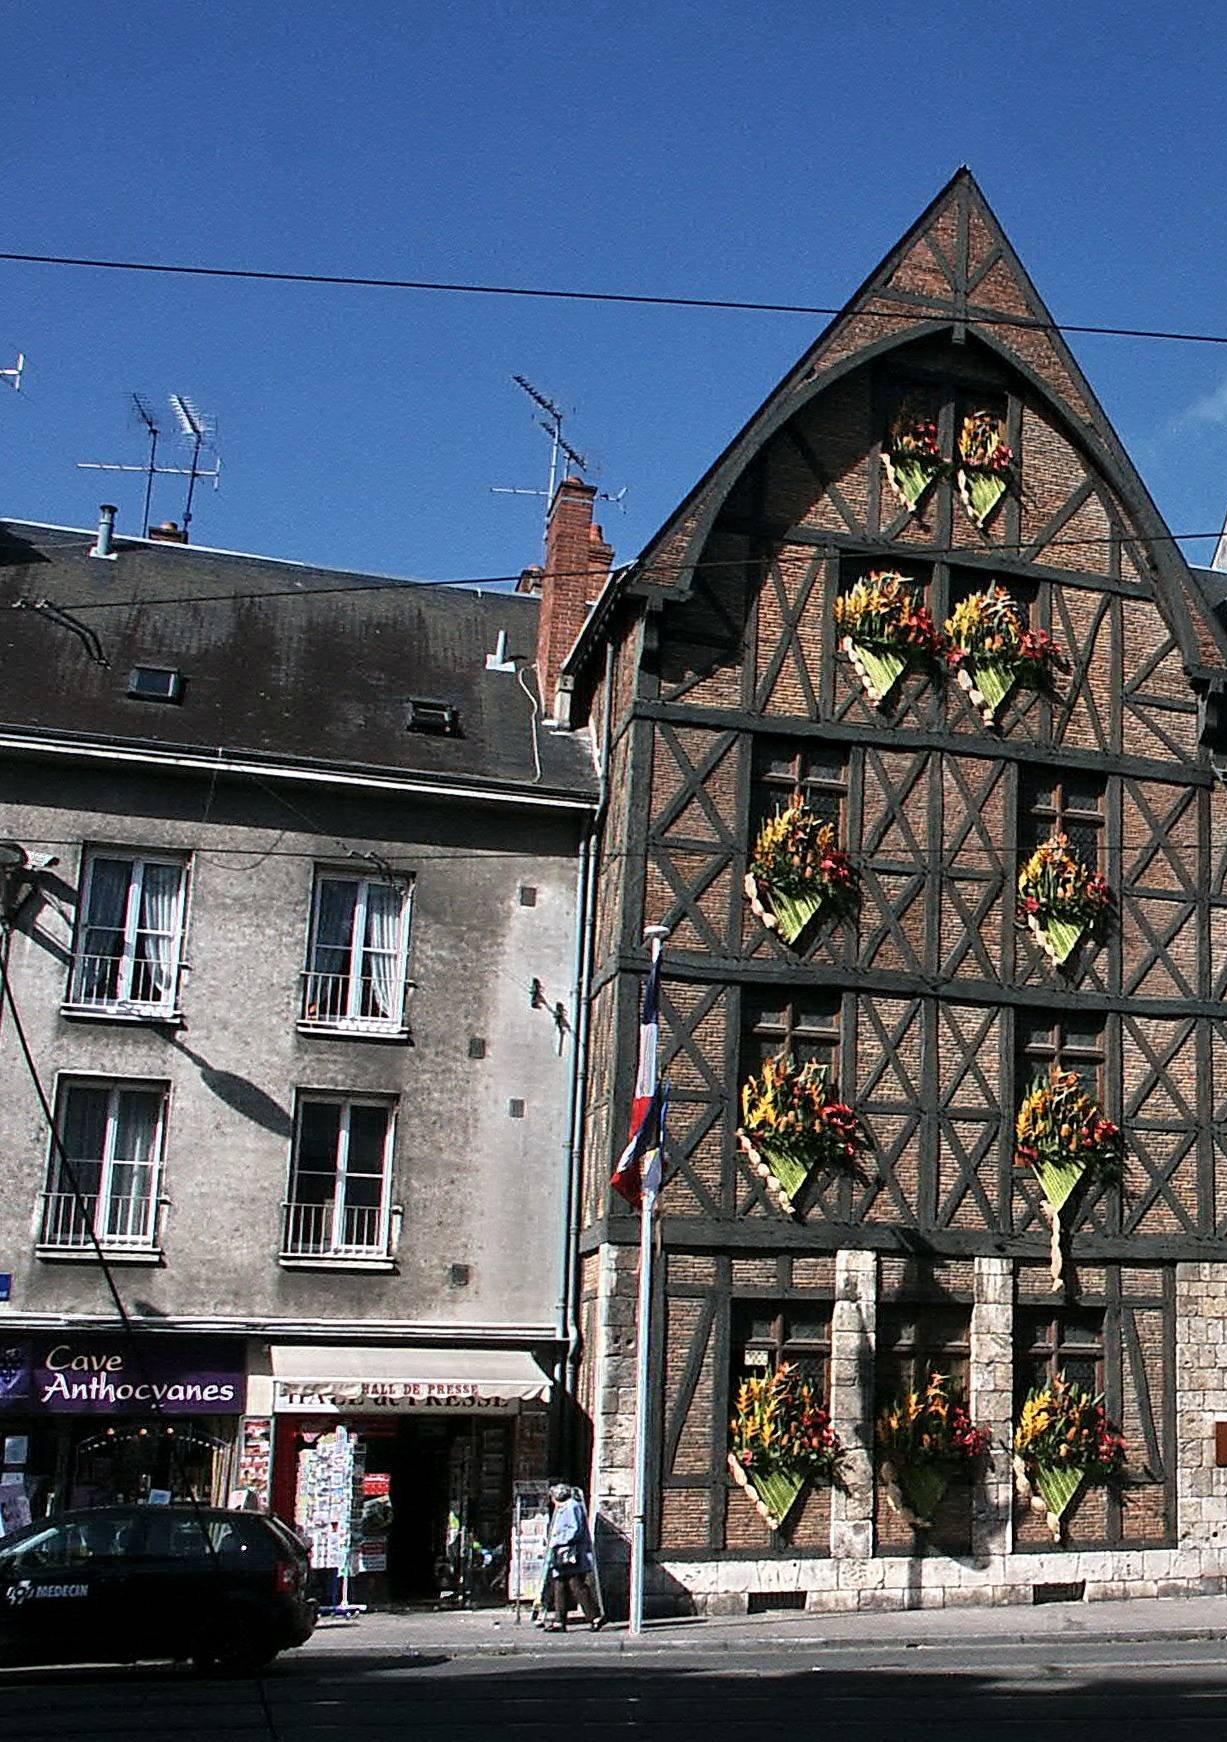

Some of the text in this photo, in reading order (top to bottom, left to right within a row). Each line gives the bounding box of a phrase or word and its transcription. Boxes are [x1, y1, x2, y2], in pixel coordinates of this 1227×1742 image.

[46, 1345, 124, 1371] Cave
[361, 1383, 480, 1397] HALL DE PRESSE
